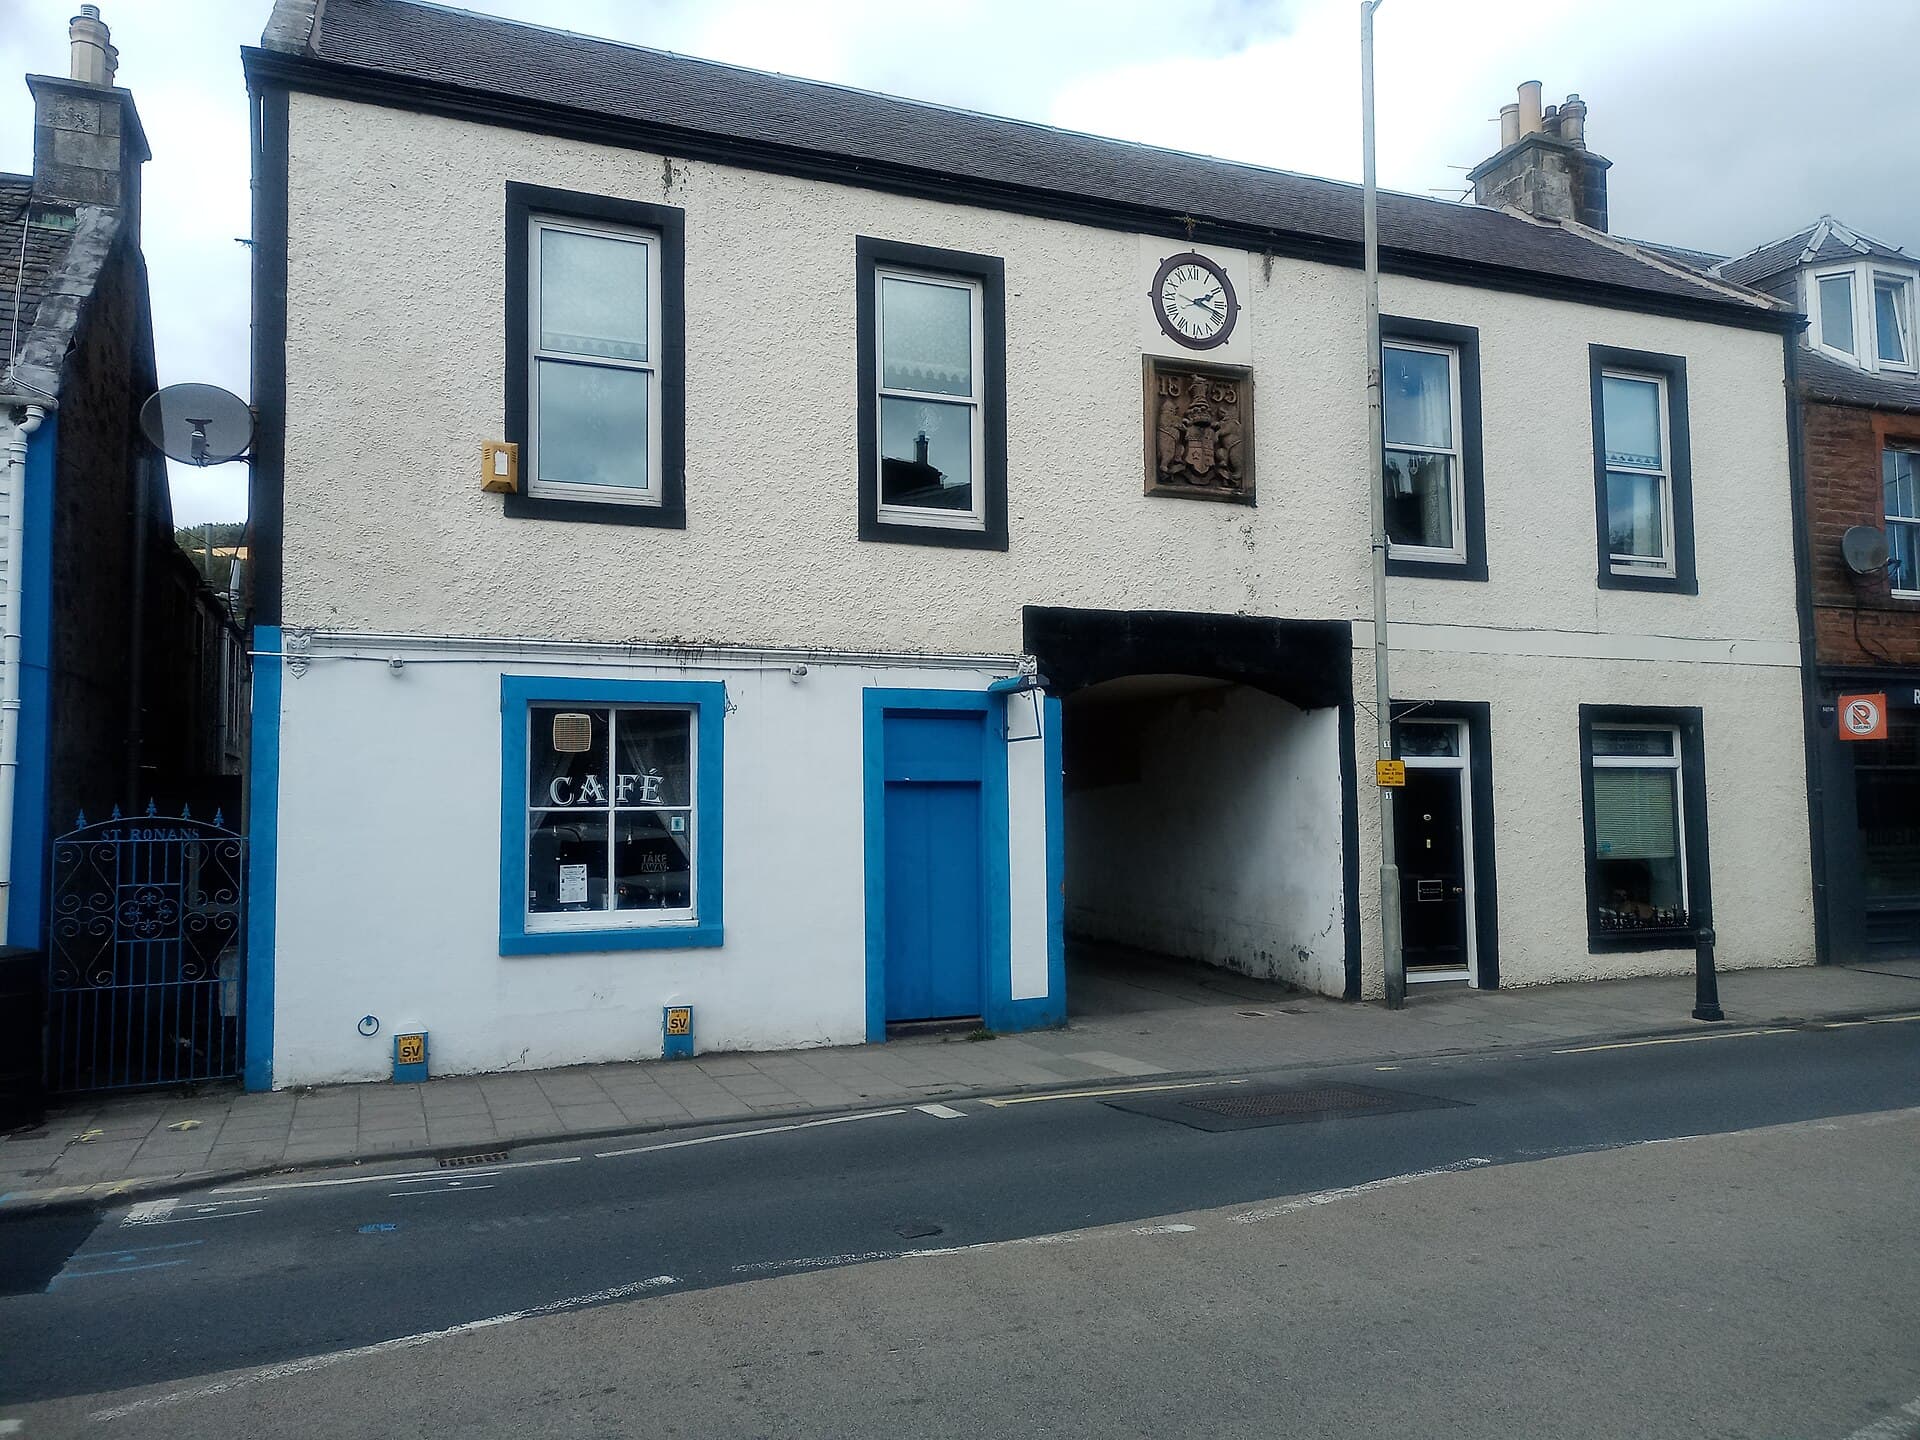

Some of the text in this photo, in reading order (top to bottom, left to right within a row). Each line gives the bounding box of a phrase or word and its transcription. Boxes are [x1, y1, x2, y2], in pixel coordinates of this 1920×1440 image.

[1187, 267, 1199, 280] XII
[1214, 301, 1224, 309] III
[549, 768, 665, 807] CAFÉ
[101, 829, 200, 841] ST RONANS
[642, 853, 667, 863] TAKE
[641, 863, 667, 873] AWAY
[670, 1018, 687, 1029] SV
[402, 1045, 420, 1057] SV
